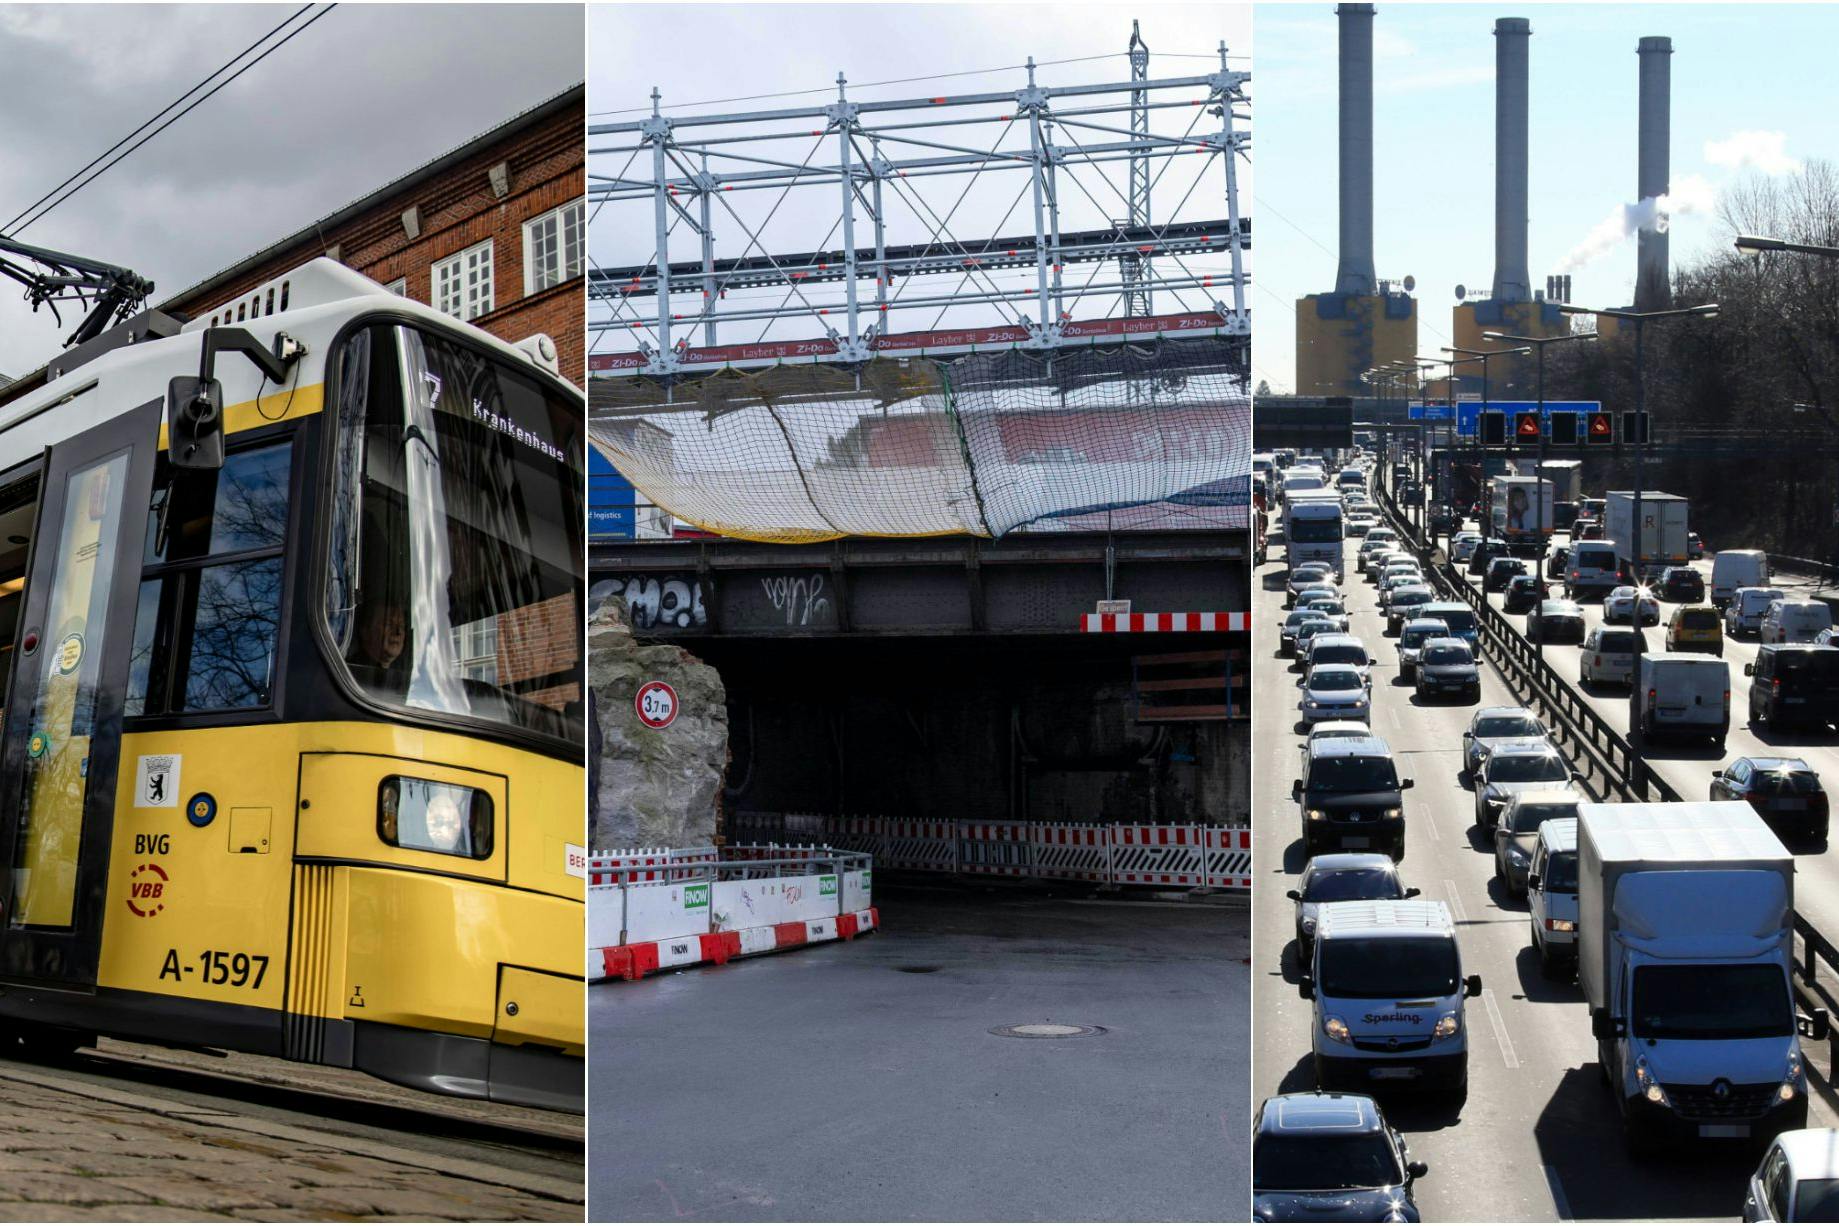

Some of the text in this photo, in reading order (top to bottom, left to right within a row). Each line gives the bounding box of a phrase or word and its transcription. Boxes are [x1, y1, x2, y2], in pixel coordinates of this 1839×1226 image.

[473, 398, 565, 463] Krankenhaus
[593, 511, 622, 520] logistics
[661, 703, 670, 713] m
[135, 834, 170, 855] BVG
[131, 882, 164, 899] VBB
[159, 948, 270, 990] A-1597
